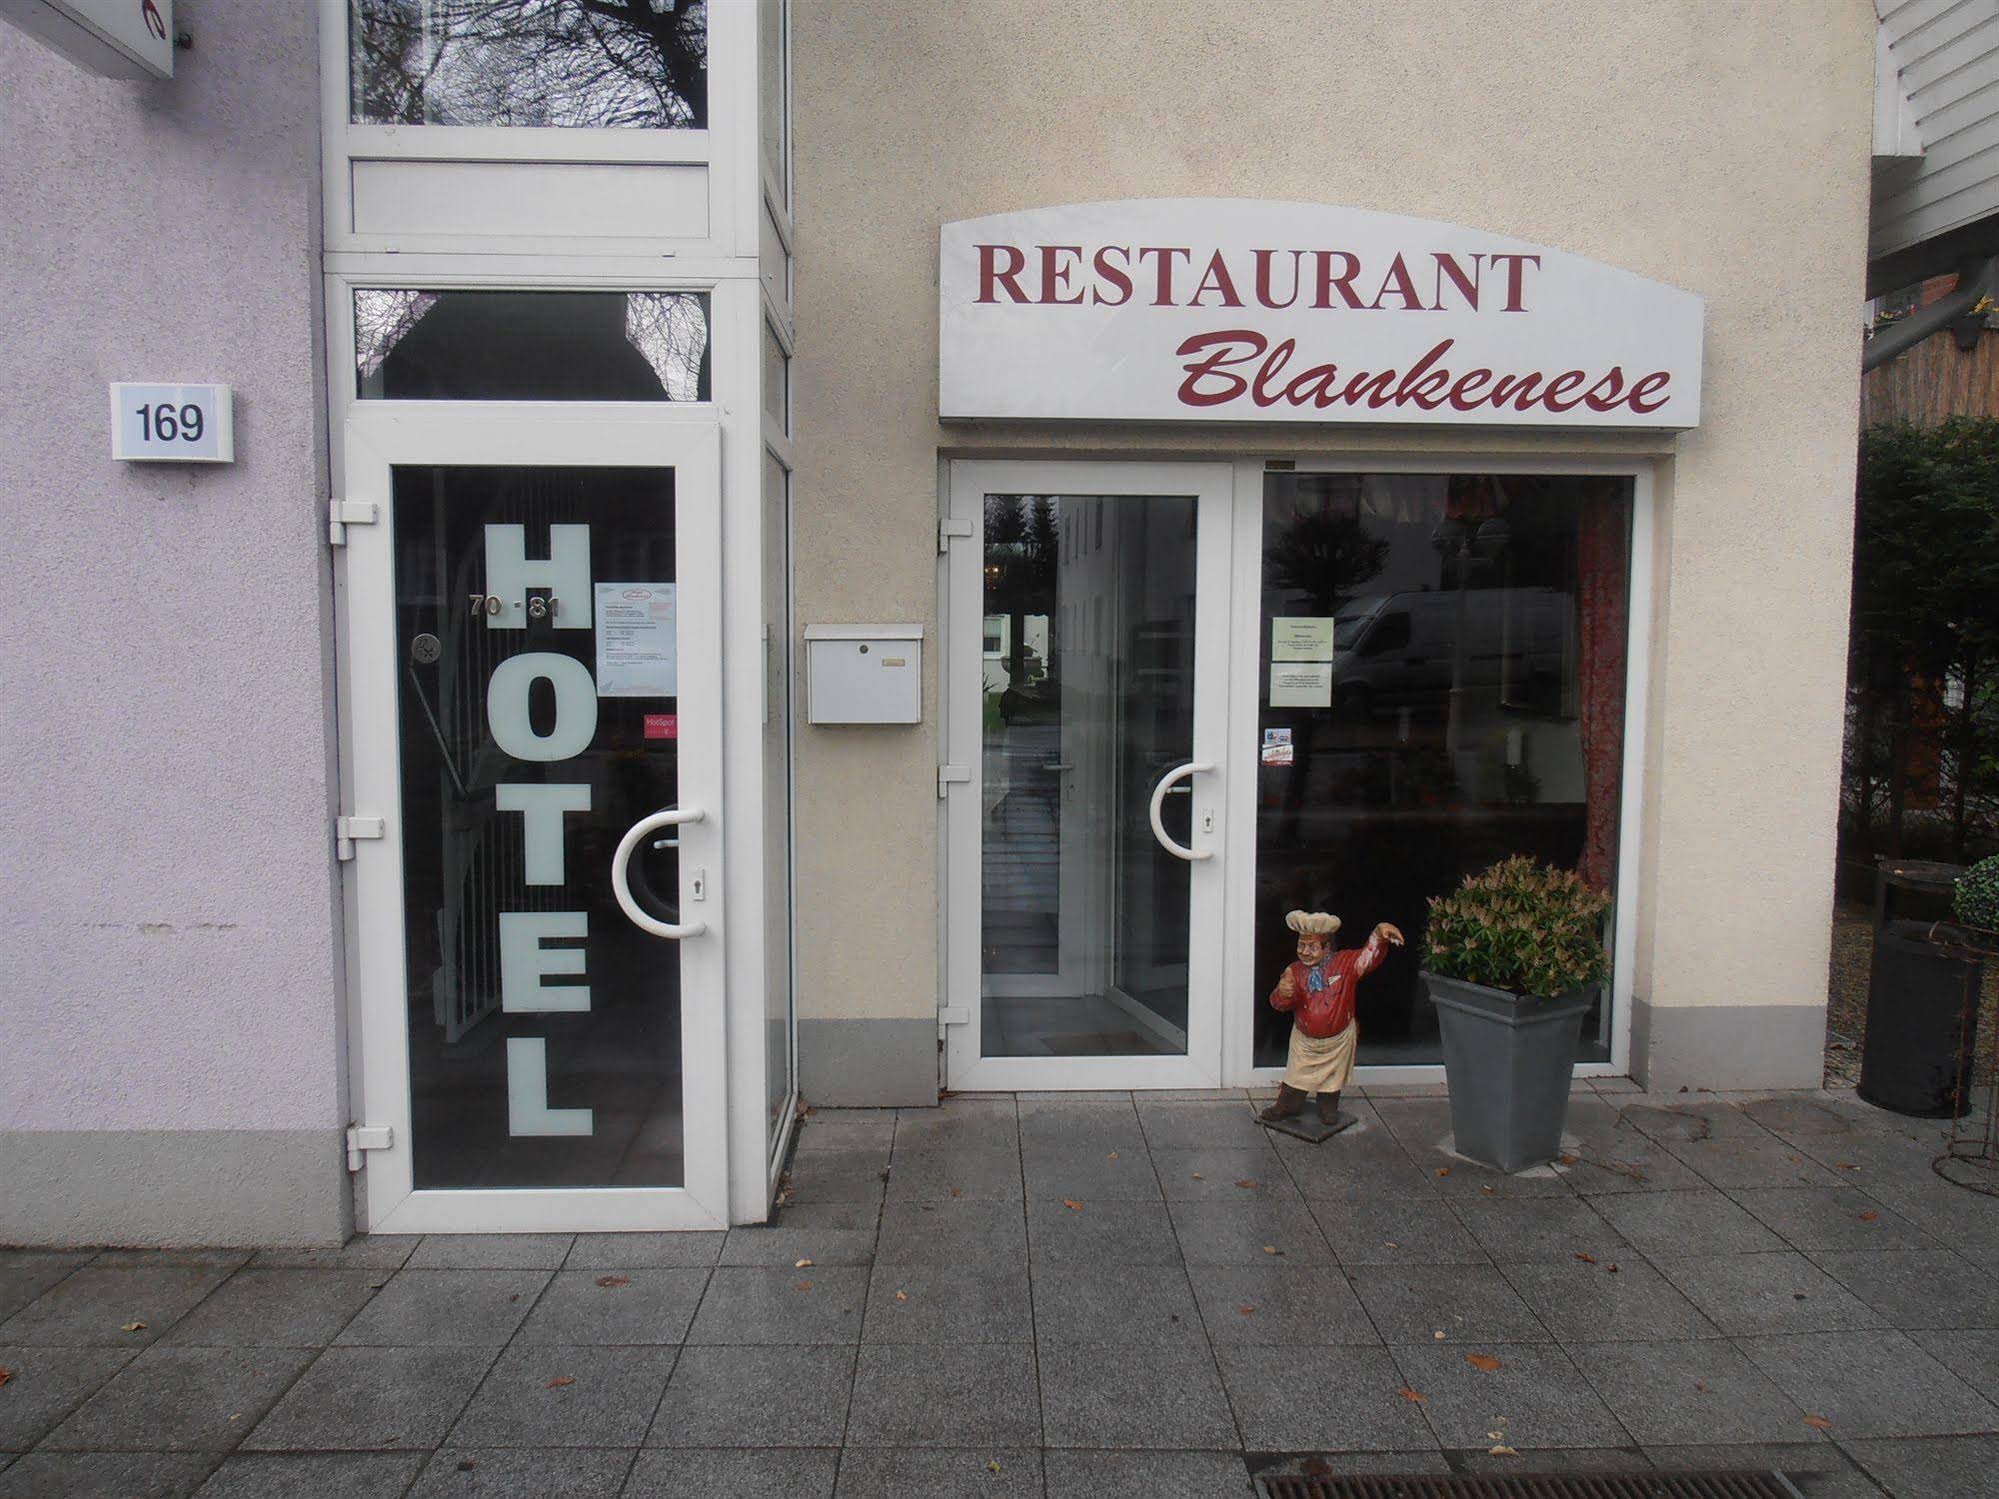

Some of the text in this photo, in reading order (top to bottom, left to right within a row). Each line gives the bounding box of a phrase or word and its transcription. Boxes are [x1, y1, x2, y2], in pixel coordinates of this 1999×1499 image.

[972, 243, 1541, 313] RESTAURANT
[1175, 329, 1671, 414] Blankenese
[136, 403, 204, 442] 169
[469, 594, 503, 616] 70
[529, 596, 560, 618] 81
[485, 523, 598, 1137] HOTEL
